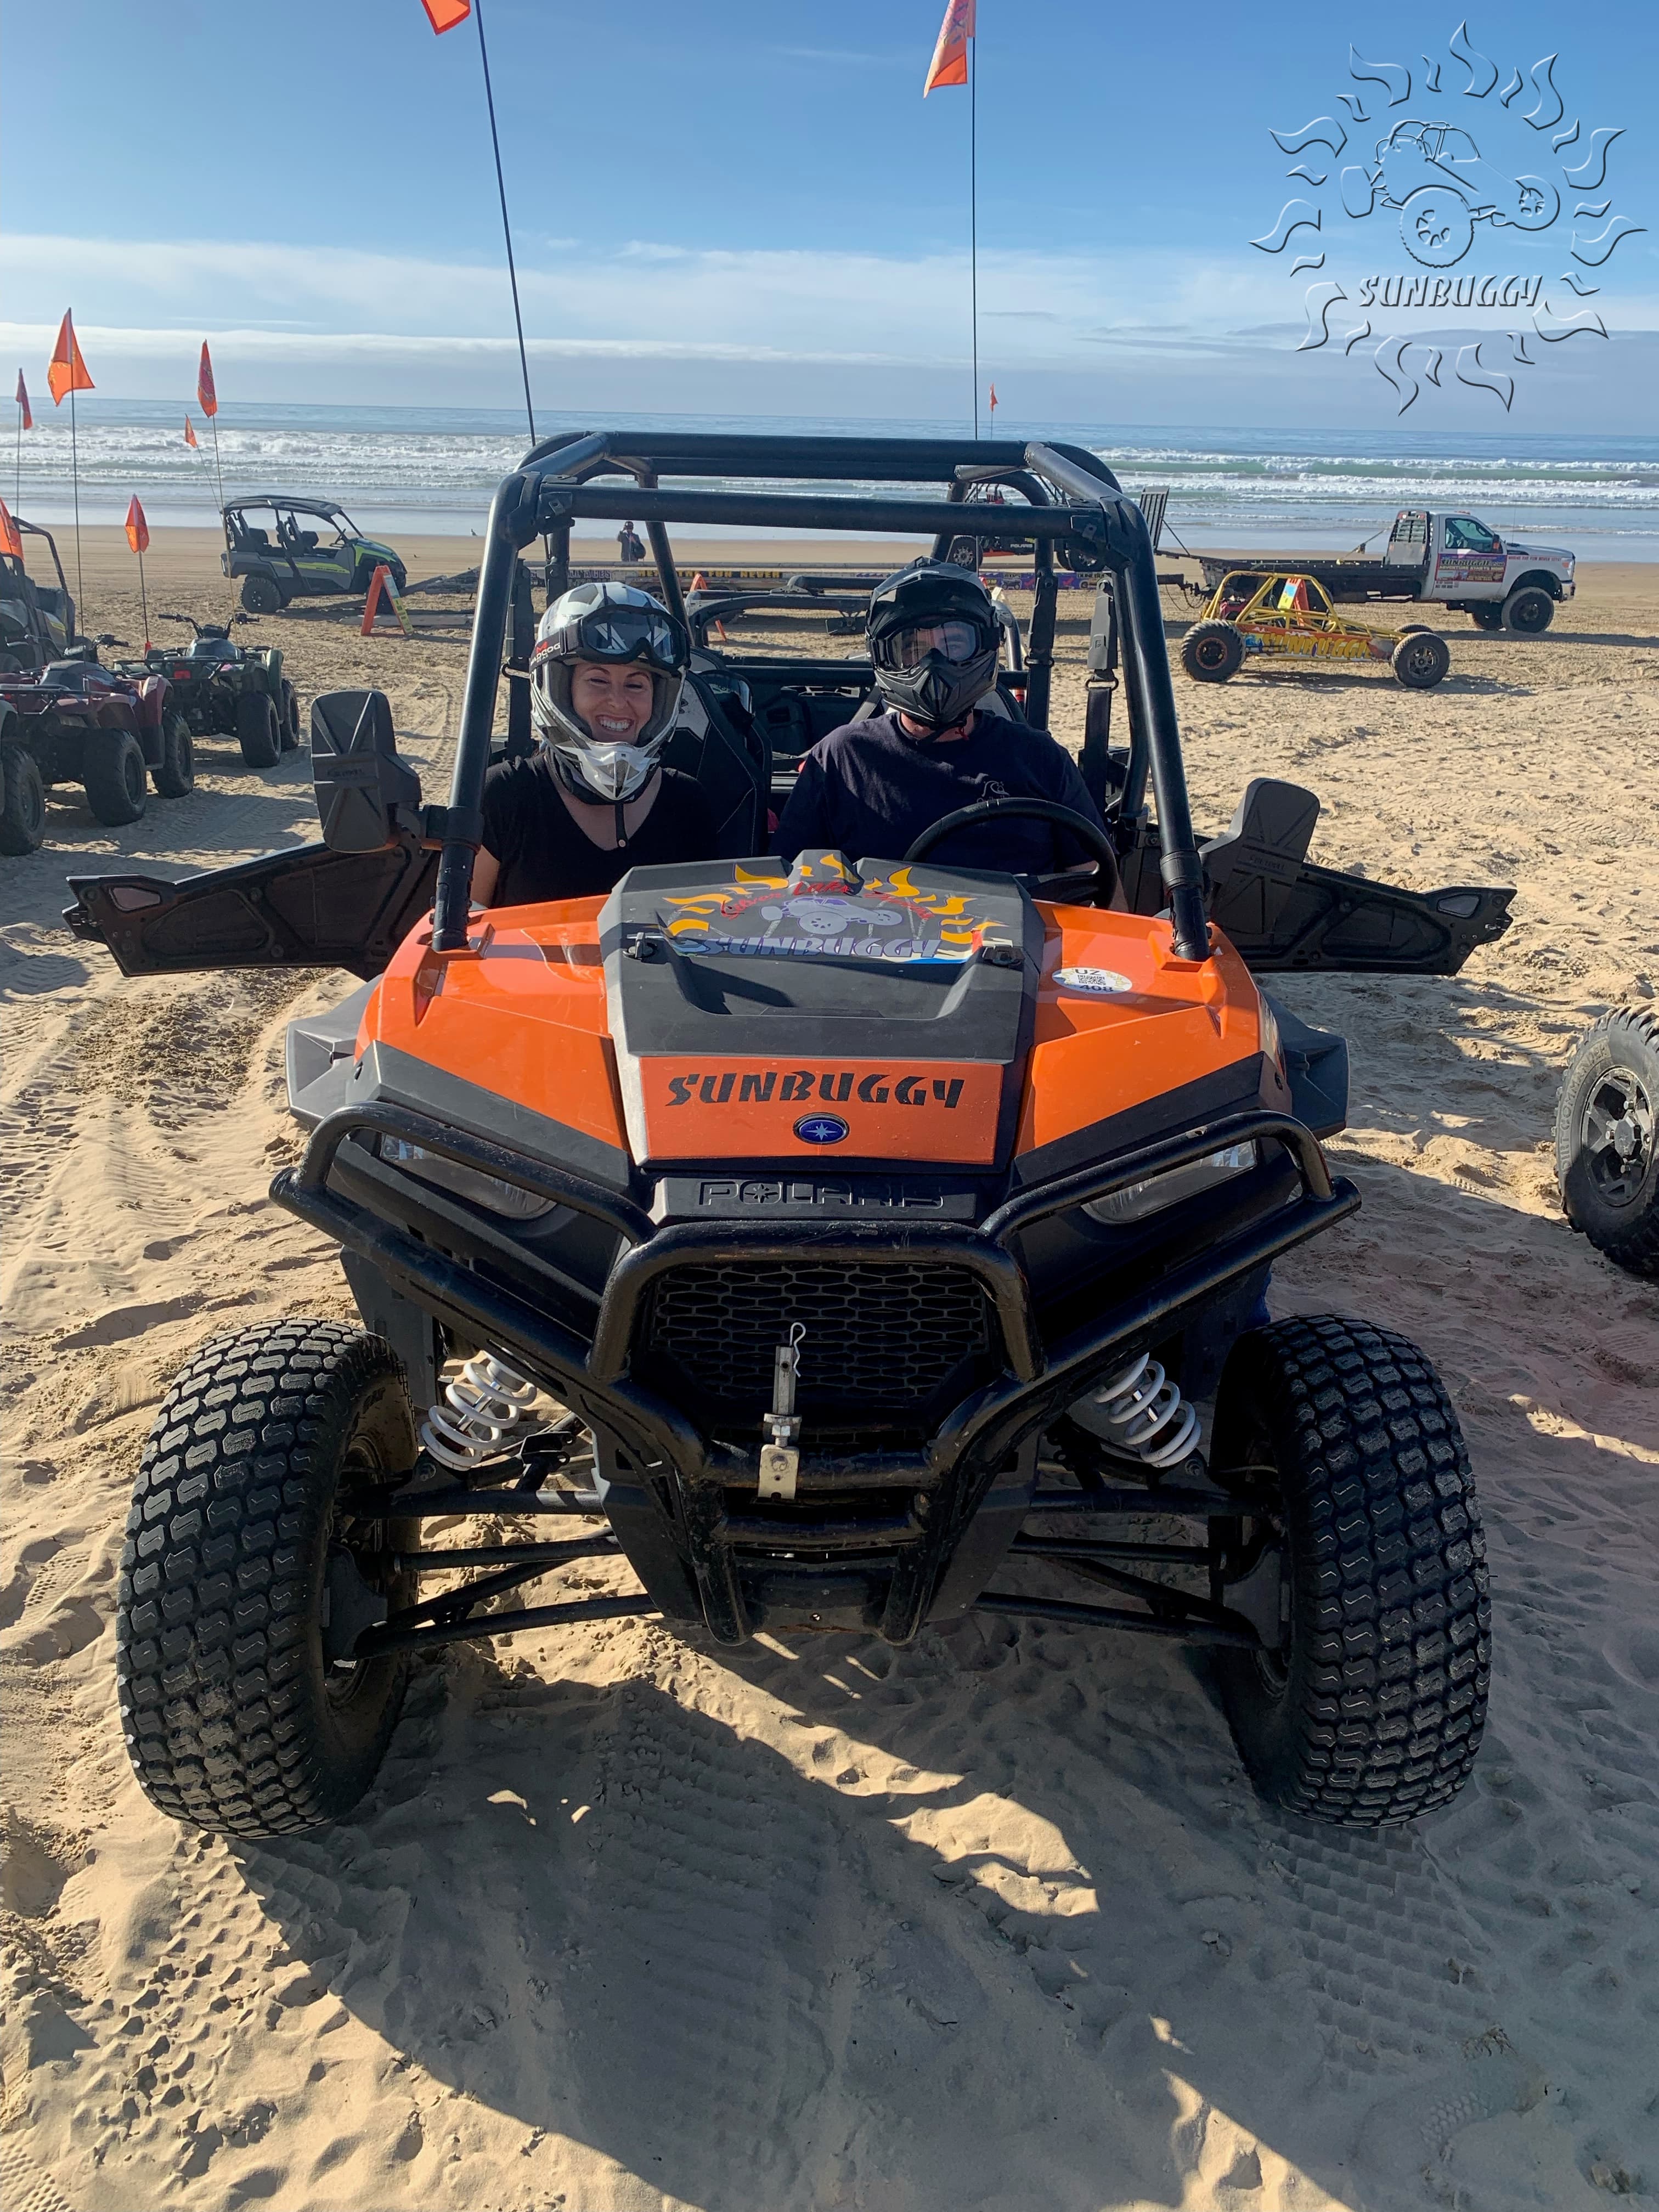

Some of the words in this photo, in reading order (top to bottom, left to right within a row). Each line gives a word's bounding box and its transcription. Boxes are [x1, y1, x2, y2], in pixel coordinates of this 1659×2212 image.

[701, 936, 942, 957] SUNBUGGY
[665, 1070, 964, 1108] SUNBUGGY
[698, 1181, 944, 1209] POLARIS
